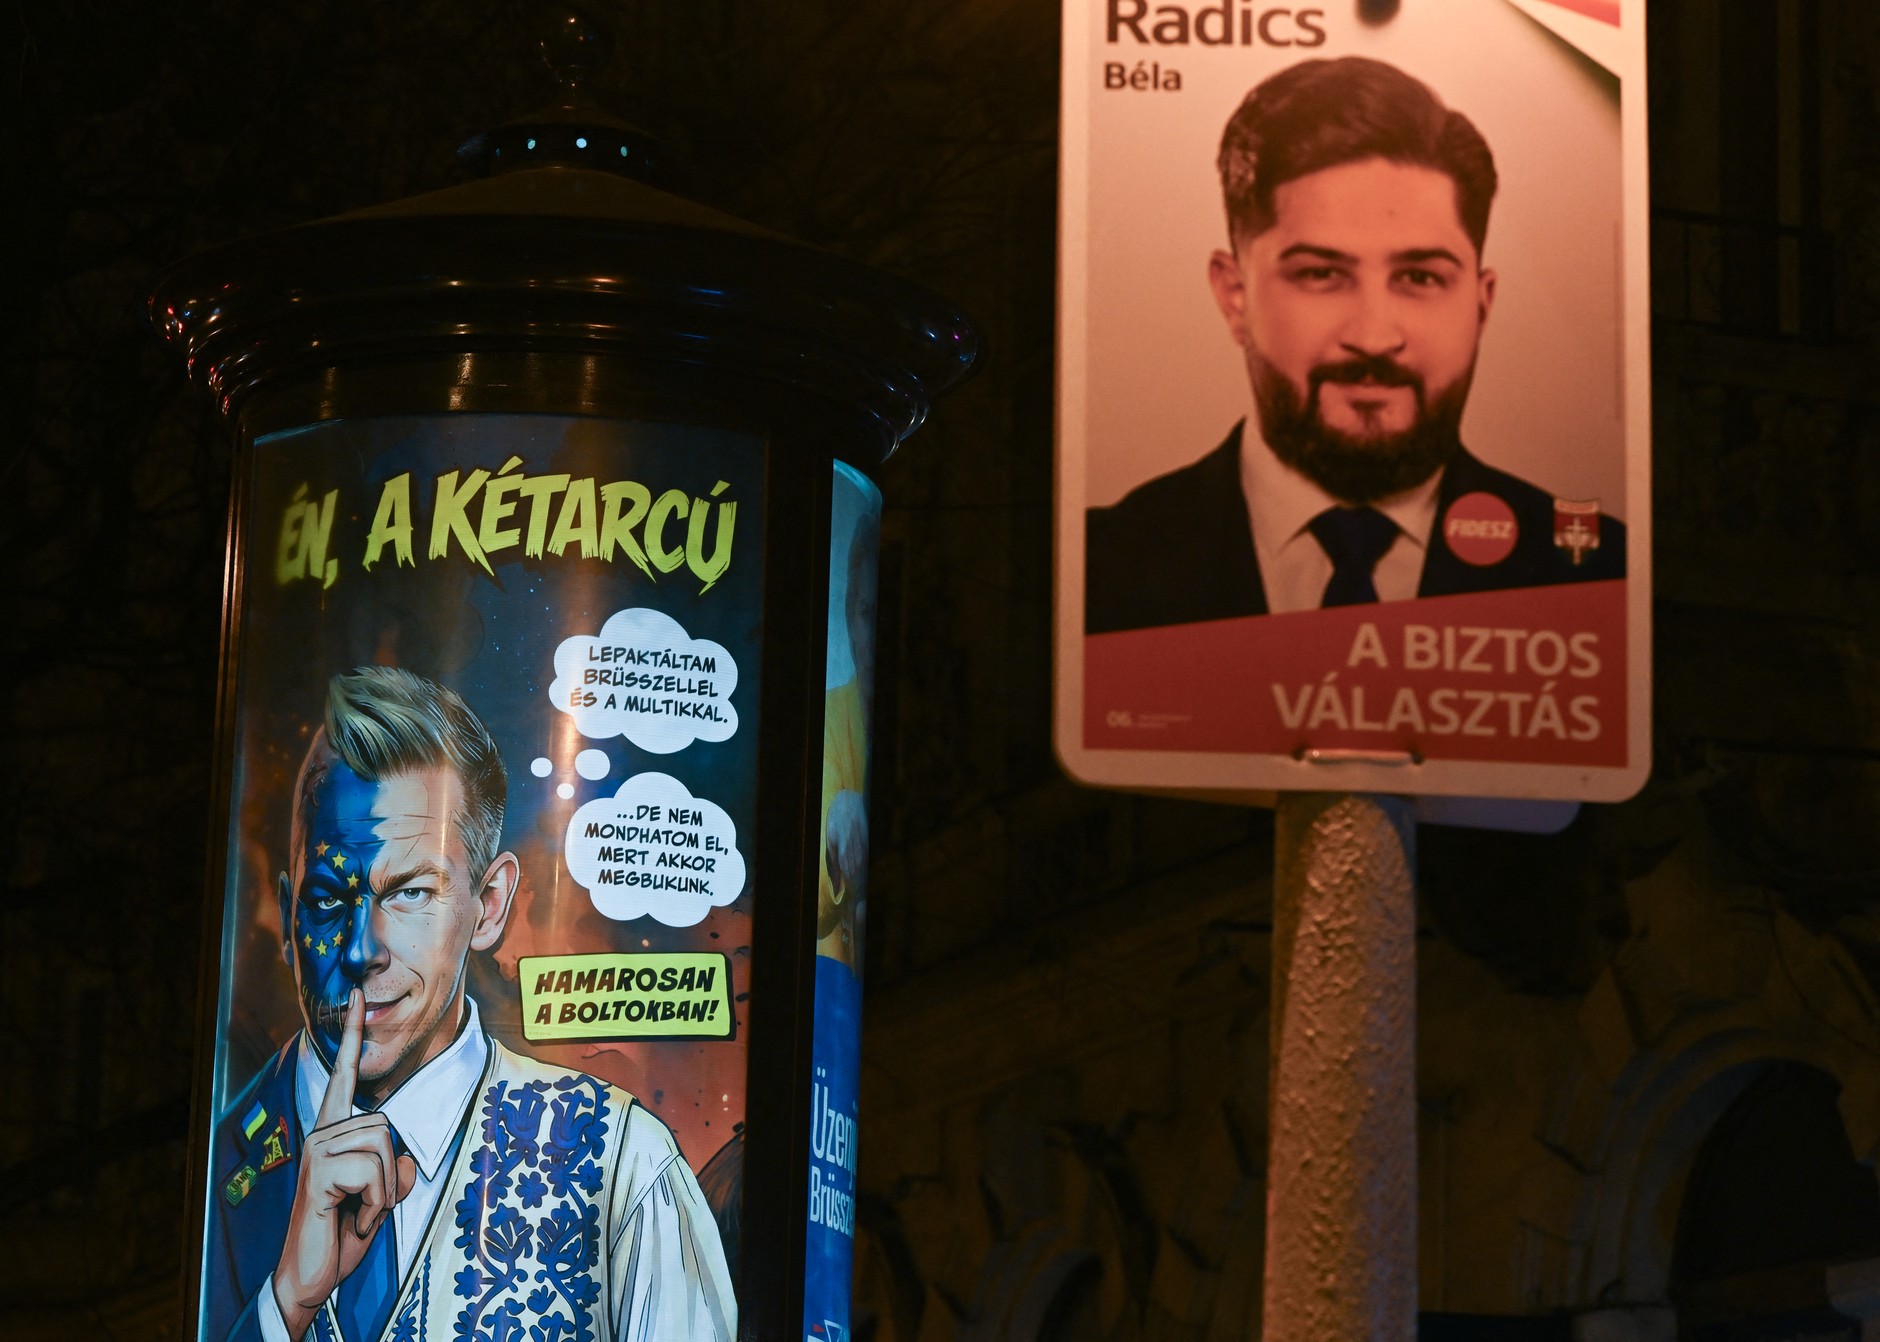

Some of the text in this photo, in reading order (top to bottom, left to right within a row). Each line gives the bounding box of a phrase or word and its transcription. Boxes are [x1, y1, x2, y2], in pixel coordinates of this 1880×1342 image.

[1105, 0, 1327, 48] Radics
[1104, 60, 1182, 92] Béla
[276, 455, 737, 596] ÉN, A KÉTARCÚ
[1447, 518, 1514, 540] FIDESZ
[589, 646, 716, 673] LEPAKTÁLTAM
[1347, 623, 1600, 677] A BIZTOS
[584, 668, 719, 697] BRÜSSZELLEL
[570, 691, 729, 724] ÉS A MULTIKKAL.
[1272, 672, 1600, 741] VÁLASZTÁS
[617, 806, 703, 827] ...DE NEM
[584, 823, 729, 855] MONDHATOM EL,
[597, 847, 716, 873] MERT AKKOR
[597, 869, 714, 896] MEGBUKUNK.
[534, 966, 716, 996] HAMAROSAN
[535, 1000, 720, 1024] A BOLTOKBAN!
